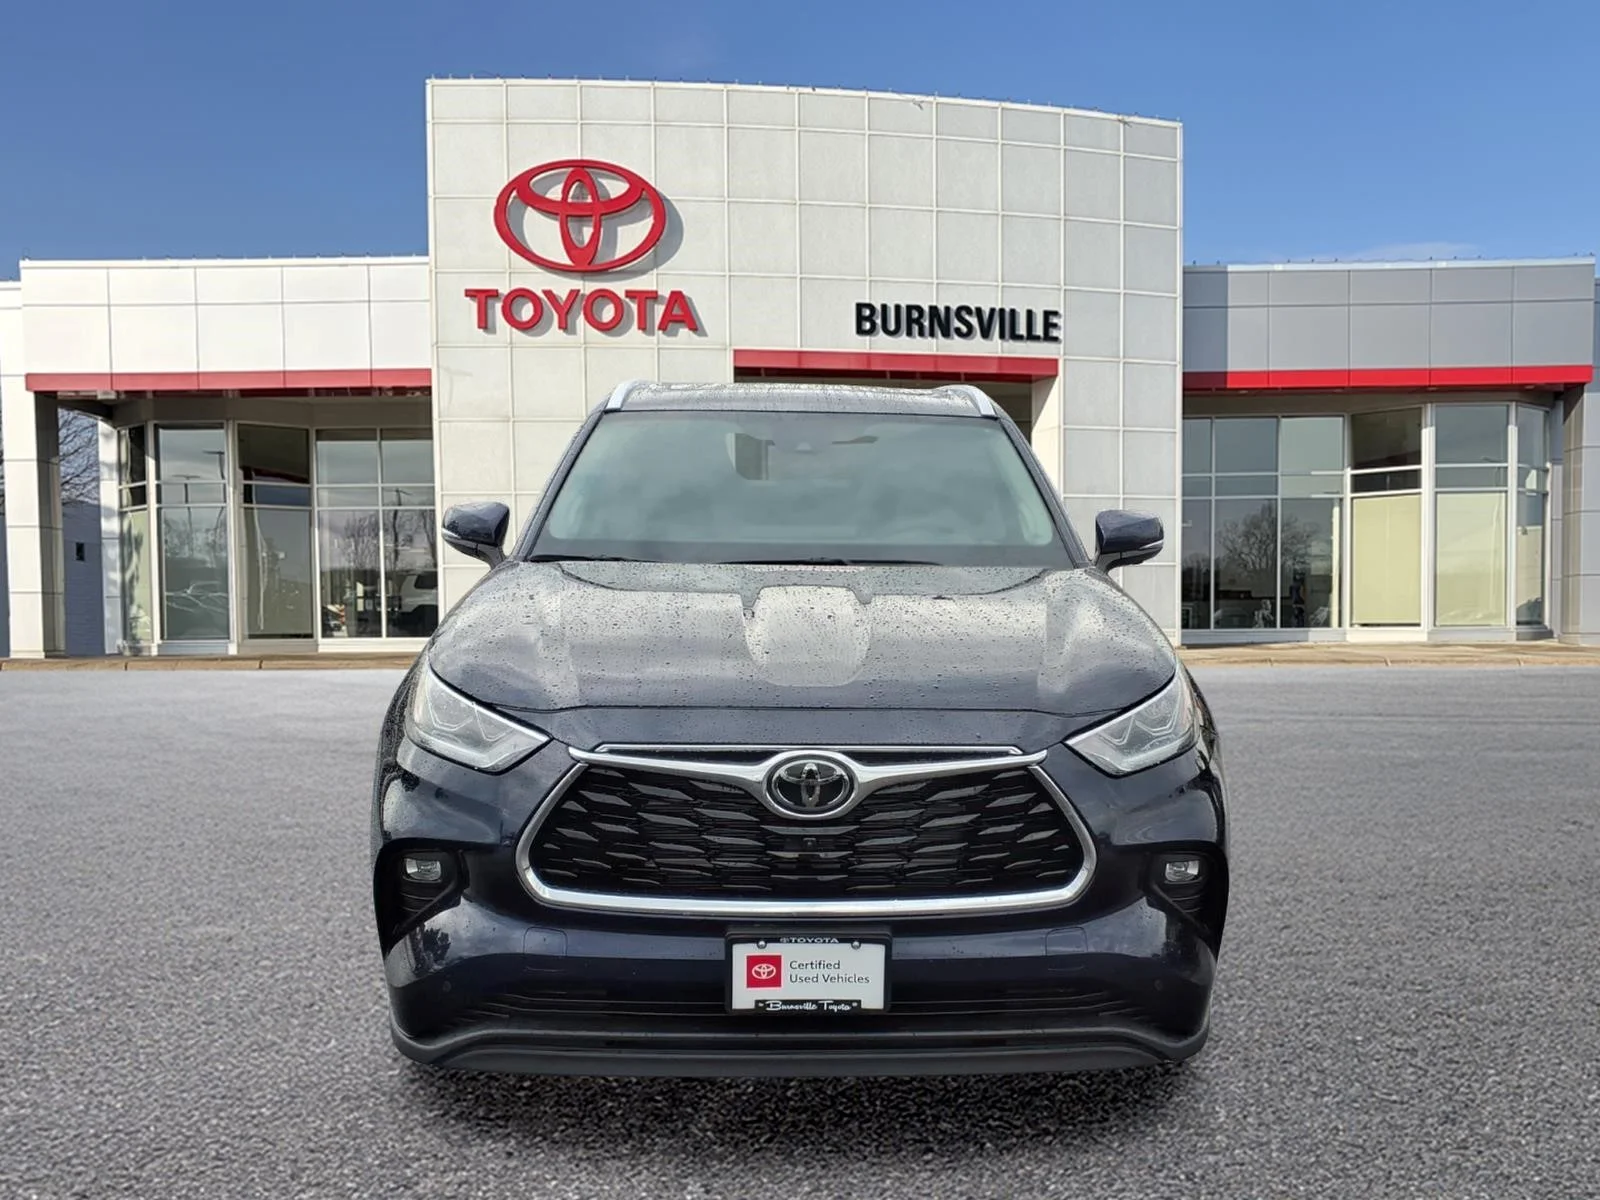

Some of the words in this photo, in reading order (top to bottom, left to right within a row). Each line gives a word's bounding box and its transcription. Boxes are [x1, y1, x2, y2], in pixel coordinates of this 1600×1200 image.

[464, 287, 699, 332] TOYOTA
[855, 302, 1061, 343] BURNSVILLE
[789, 960, 841, 970] Certified
[789, 974, 819, 984] Used
[822, 973, 870, 984] Vehicles
[765, 1000, 818, 1011] Burnsville
[818, 1000, 852, 1013] Toyota
